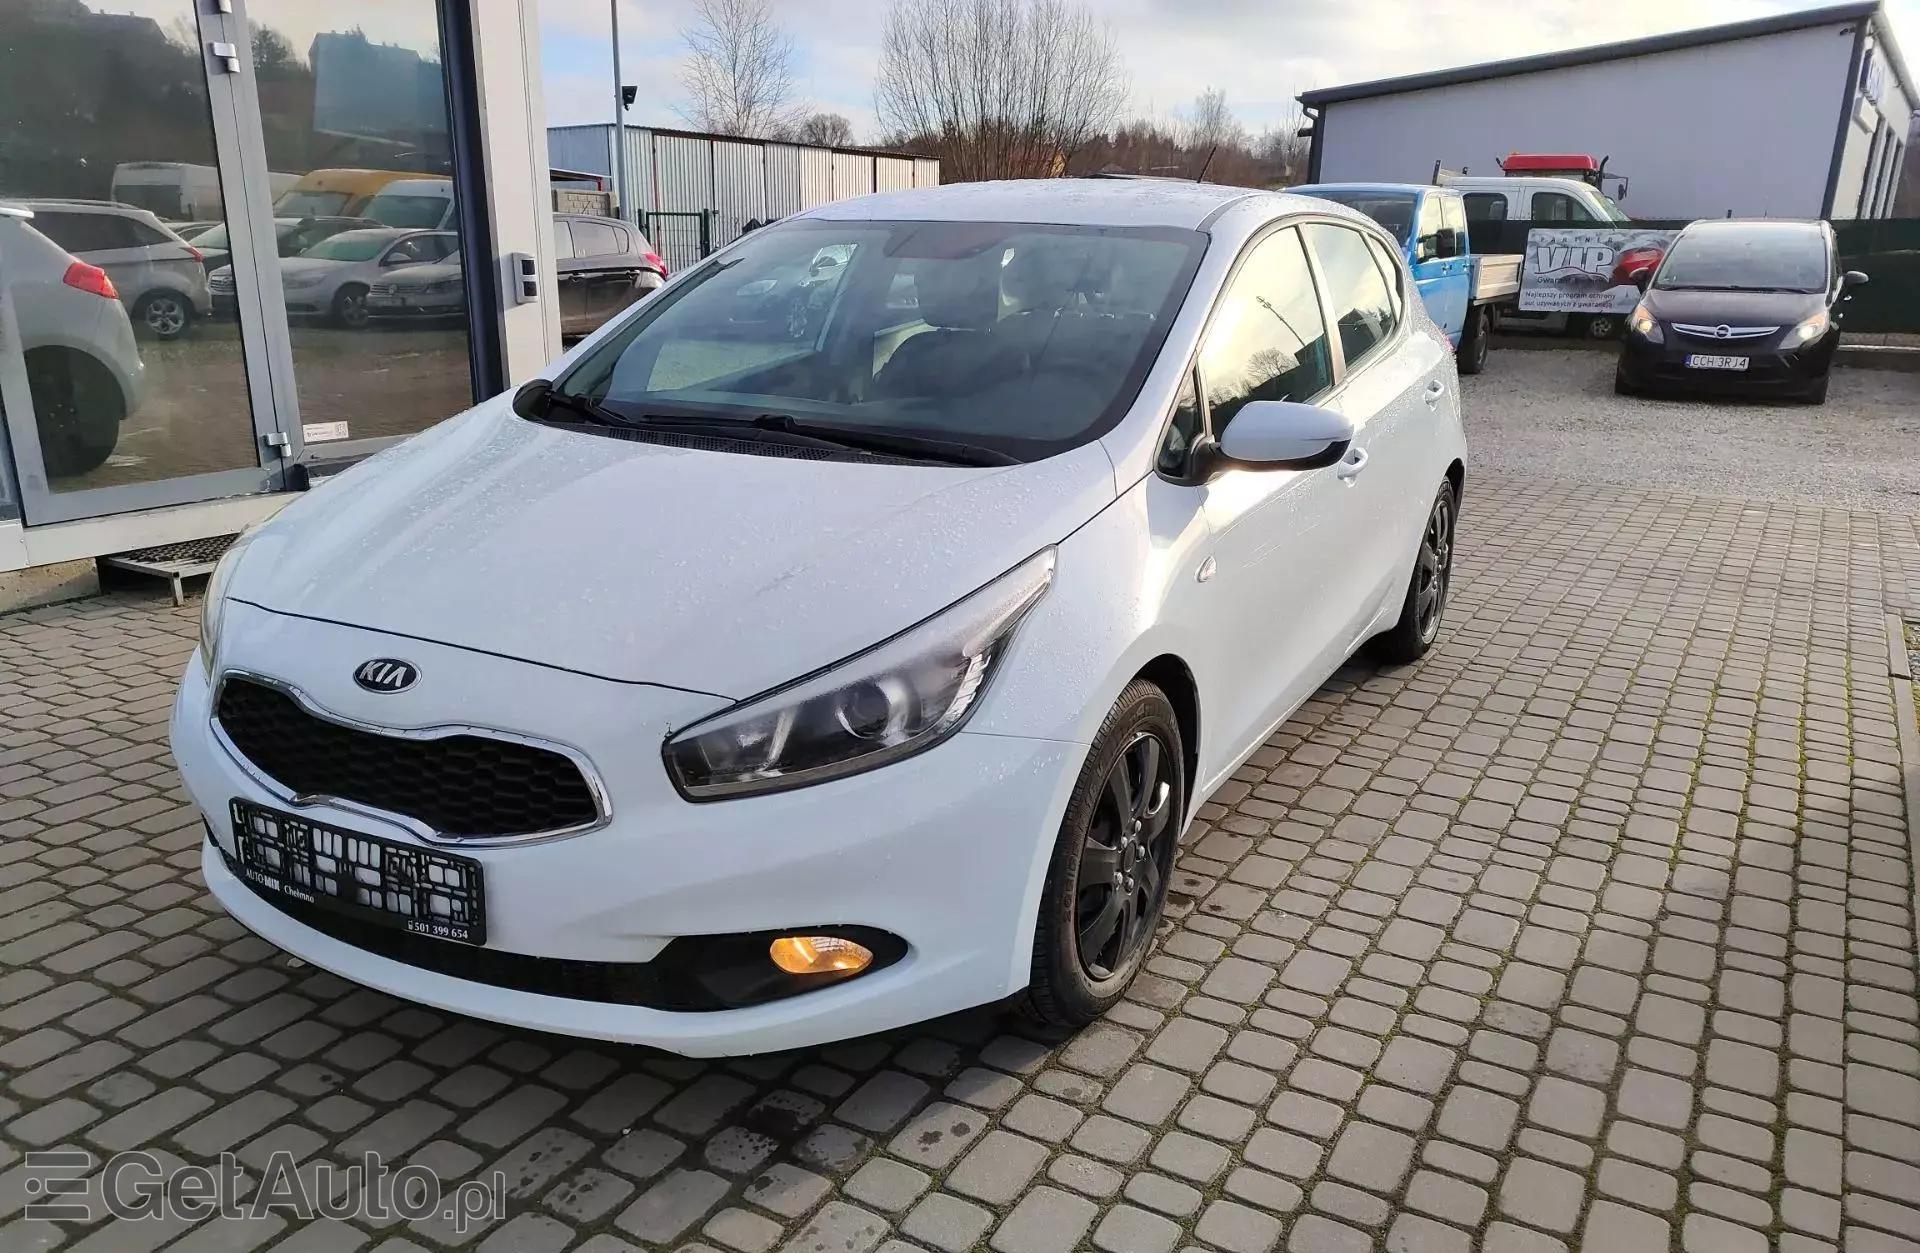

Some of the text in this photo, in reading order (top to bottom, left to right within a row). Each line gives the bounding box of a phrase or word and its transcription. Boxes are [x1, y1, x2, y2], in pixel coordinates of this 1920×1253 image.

[1537, 246, 1614, 273] VIP
[1558, 292, 1587, 300] program
[1693, 356, 1746, 368] CCH 3RJ4
[359, 661, 408, 688] KIA
[414, 922, 469, 939] 501 399 654
